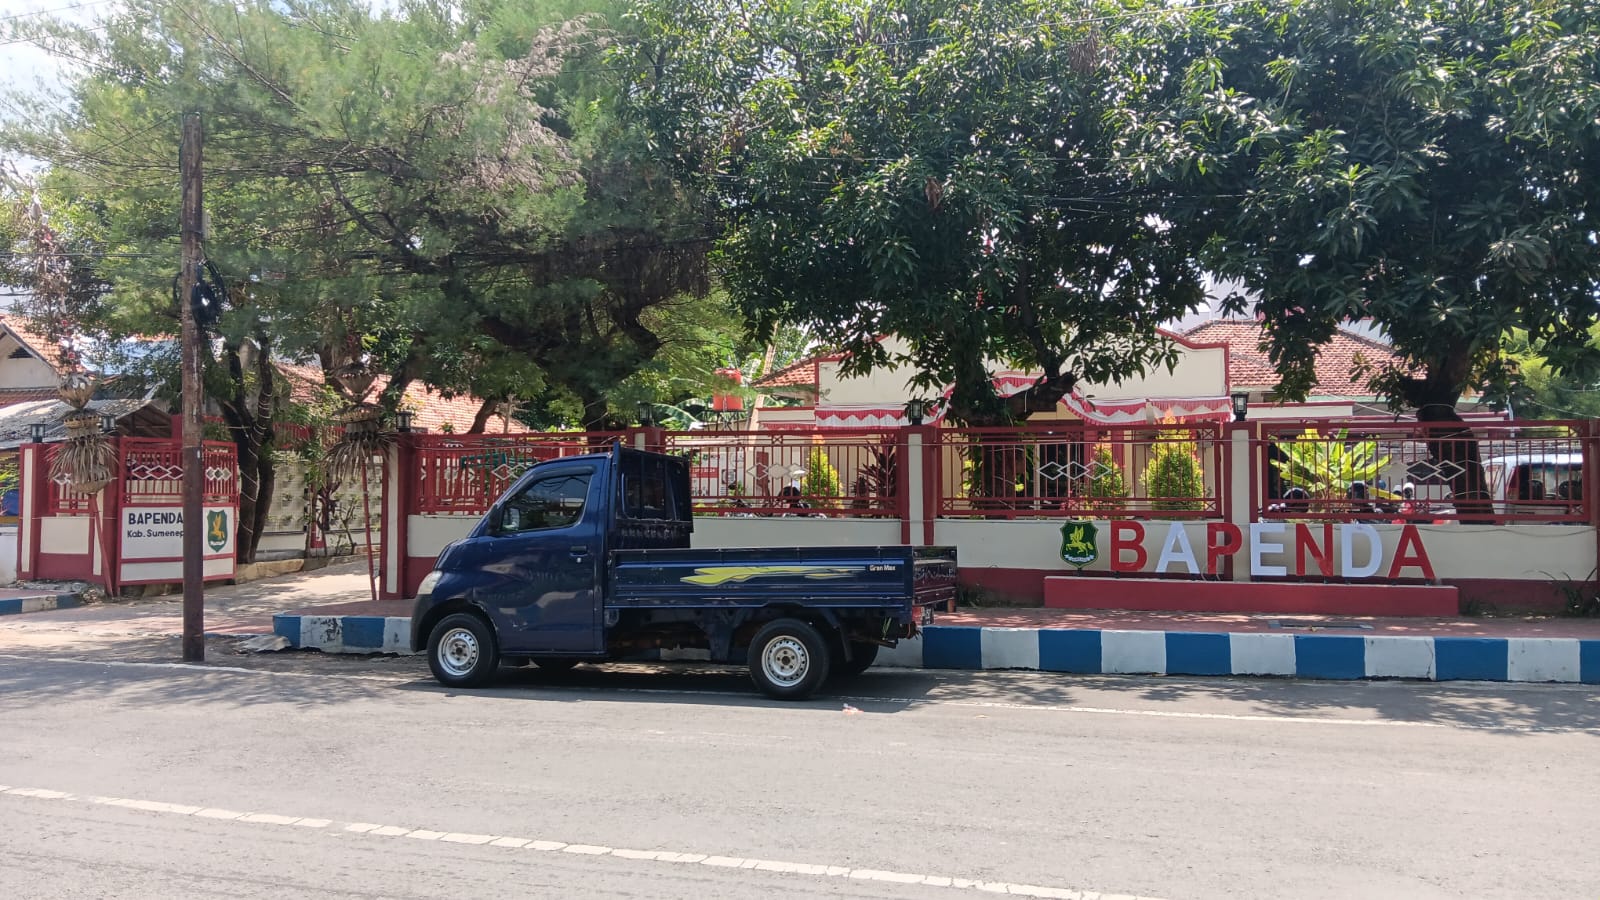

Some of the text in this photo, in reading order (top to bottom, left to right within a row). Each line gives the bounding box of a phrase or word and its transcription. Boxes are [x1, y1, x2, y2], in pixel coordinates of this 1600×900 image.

[128, 512, 184, 525] BAPENDA
[127, 530, 145, 538] Kab.
[1110, 520, 1436, 580] BAPENDA
